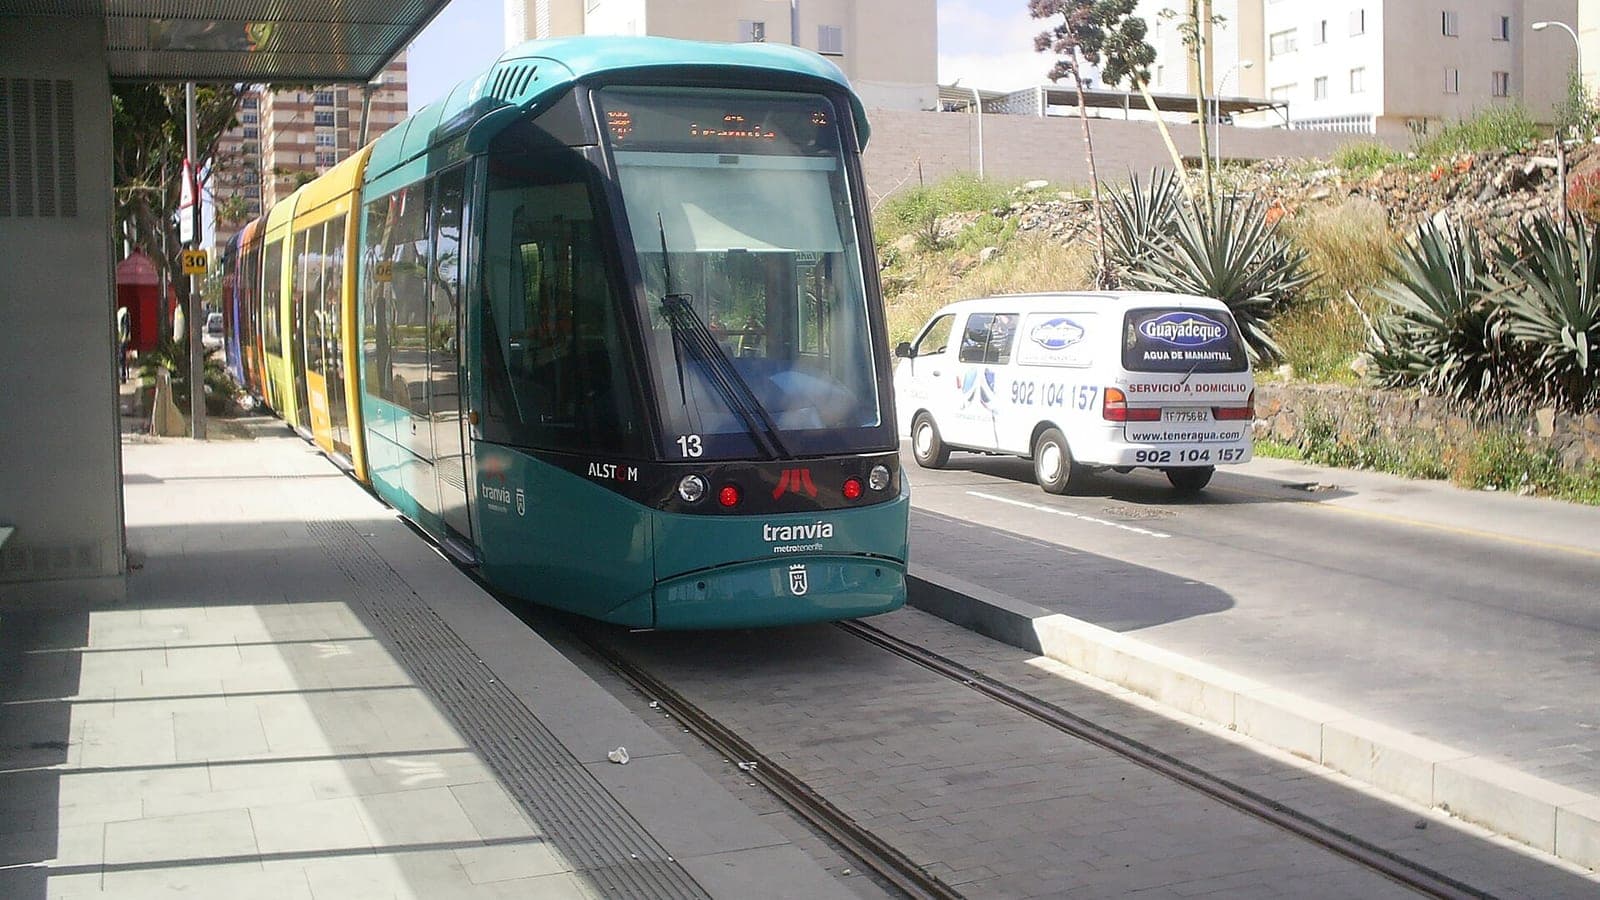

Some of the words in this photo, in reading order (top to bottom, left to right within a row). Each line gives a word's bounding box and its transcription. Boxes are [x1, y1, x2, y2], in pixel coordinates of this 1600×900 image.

[185, 256, 206, 268] 30
[1146, 318, 1221, 341] Guayadeque
[1143, 351, 1170, 361] AGUA
[1171, 351, 1183, 360] DE
[1184, 351, 1232, 361] MANANTIAL
[1011, 380, 1034, 405] 902
[1041, 382, 1064, 407] 104
[1072, 385, 1098, 411] 157
[1129, 383, 1180, 393] SERVICIO
[1184, 384, 1191, 393] A
[1195, 384, 1246, 393] DOMICILIO
[1132, 431, 1240, 442] www.teneragua.com
[676, 434, 703, 458] 13
[1136, 450, 1171, 463] 902
[1180, 449, 1210, 462] 104
[1218, 448, 1245, 461] 157
[588, 462, 638, 482] ALSTOM
[763, 521, 833, 541] tranvía
